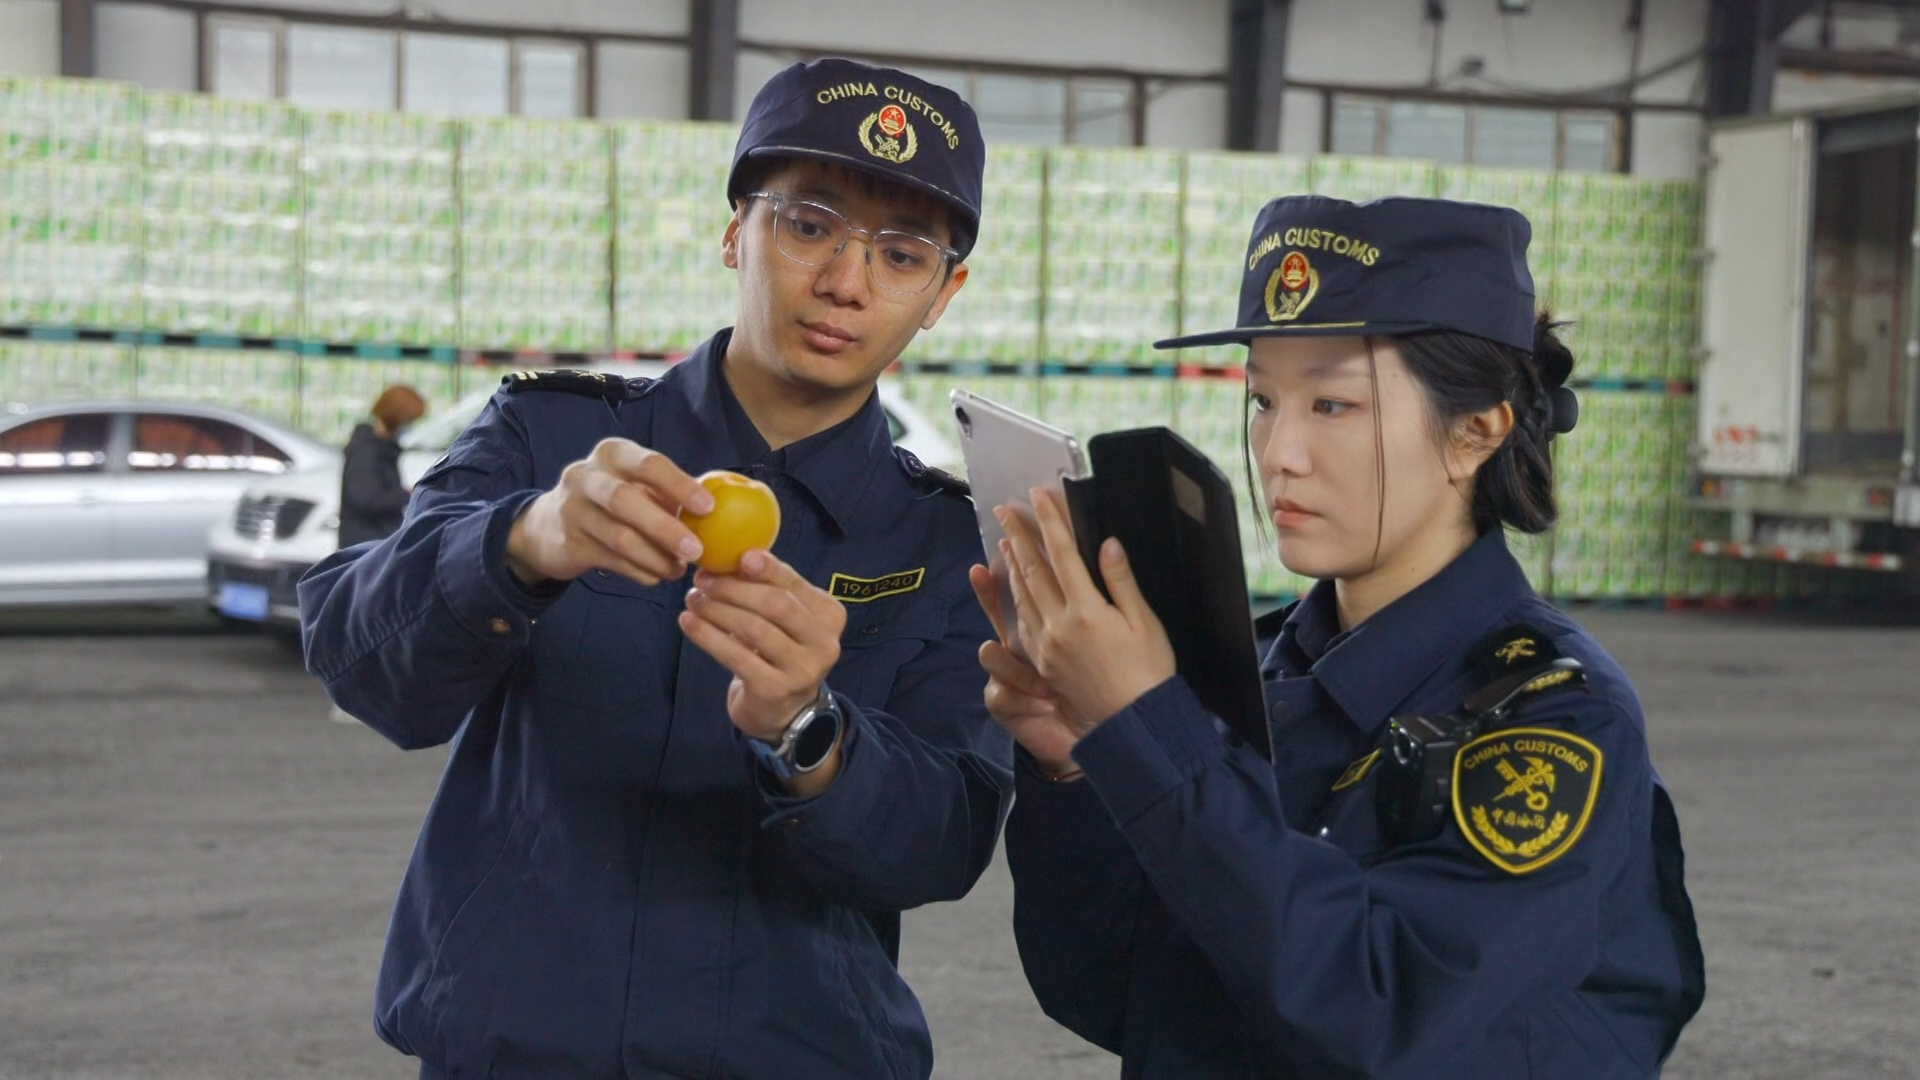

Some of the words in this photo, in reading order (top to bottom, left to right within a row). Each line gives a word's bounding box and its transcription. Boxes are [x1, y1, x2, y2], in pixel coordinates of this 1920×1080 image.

[817, 82, 878, 104] CHINA
[884, 85, 959, 150] CUSTOMS
[1249, 232, 1281, 271] CHINA
[1284, 227, 1380, 266] CUSTOMS
[842, 575, 913, 595] 1961240
[1463, 742, 1510, 769] CHINA
[1513, 739, 1589, 772] CUSTOMS
